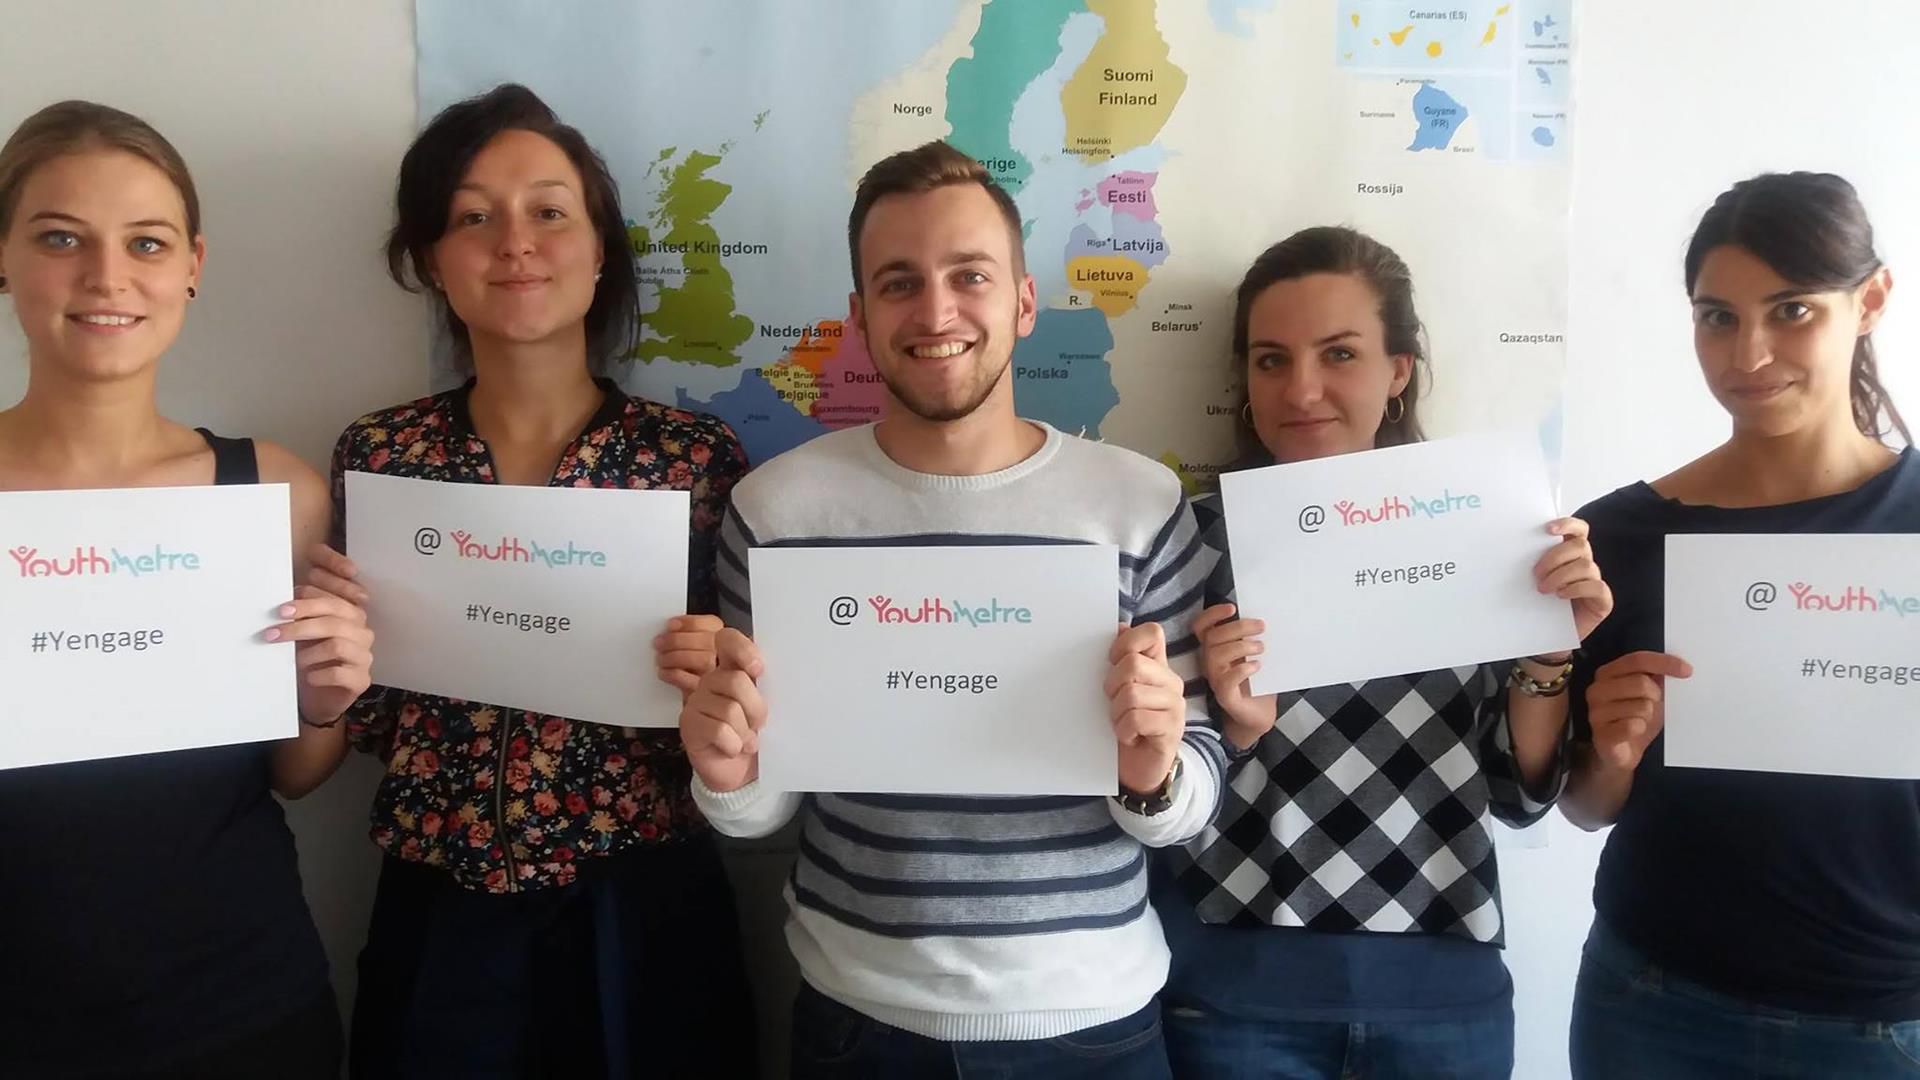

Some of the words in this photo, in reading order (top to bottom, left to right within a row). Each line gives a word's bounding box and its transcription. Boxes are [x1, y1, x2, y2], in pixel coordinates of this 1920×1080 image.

[1409, 10, 1447, 20] Canarias
[1449, 10, 1467, 21] (ES)
[1103, 68, 1153, 82] Suomi
[1099, 91, 1157, 106] Finland
[893, 103, 932, 116] Norge
[1431, 119, 1449, 128] (FR)
[1077, 137, 1111, 145] Helsinki
[1062, 147, 1111, 156] Helsingfors
[1357, 182, 1403, 195] Rossija
[1108, 190, 1146, 203] Eesti
[634, 241, 688, 254] United
[694, 241, 767, 257] Kingdom
[1113, 238, 1164, 253] Latvija
[1077, 269, 1134, 281] Lietuva
[1069, 295, 1083, 306] R.
[1169, 303, 1192, 311] Minsk
[761, 325, 843, 338] Nederland
[1499, 332, 1563, 345] Qazaqstan
[1016, 366, 1069, 380] Polska
[777, 389, 829, 401] Belgique
[1298, 505, 1325, 533] @
[414, 527, 441, 555] @
[1354, 561, 1456, 587] #Yengage
[1745, 581, 1777, 611] @
[829, 596, 859, 625] @
[466, 604, 571, 634] #Yengage
[31, 629, 164, 653] #Yengage
[1801, 658, 1920, 686] #Yengage
[886, 671, 998, 694] #Yengage
